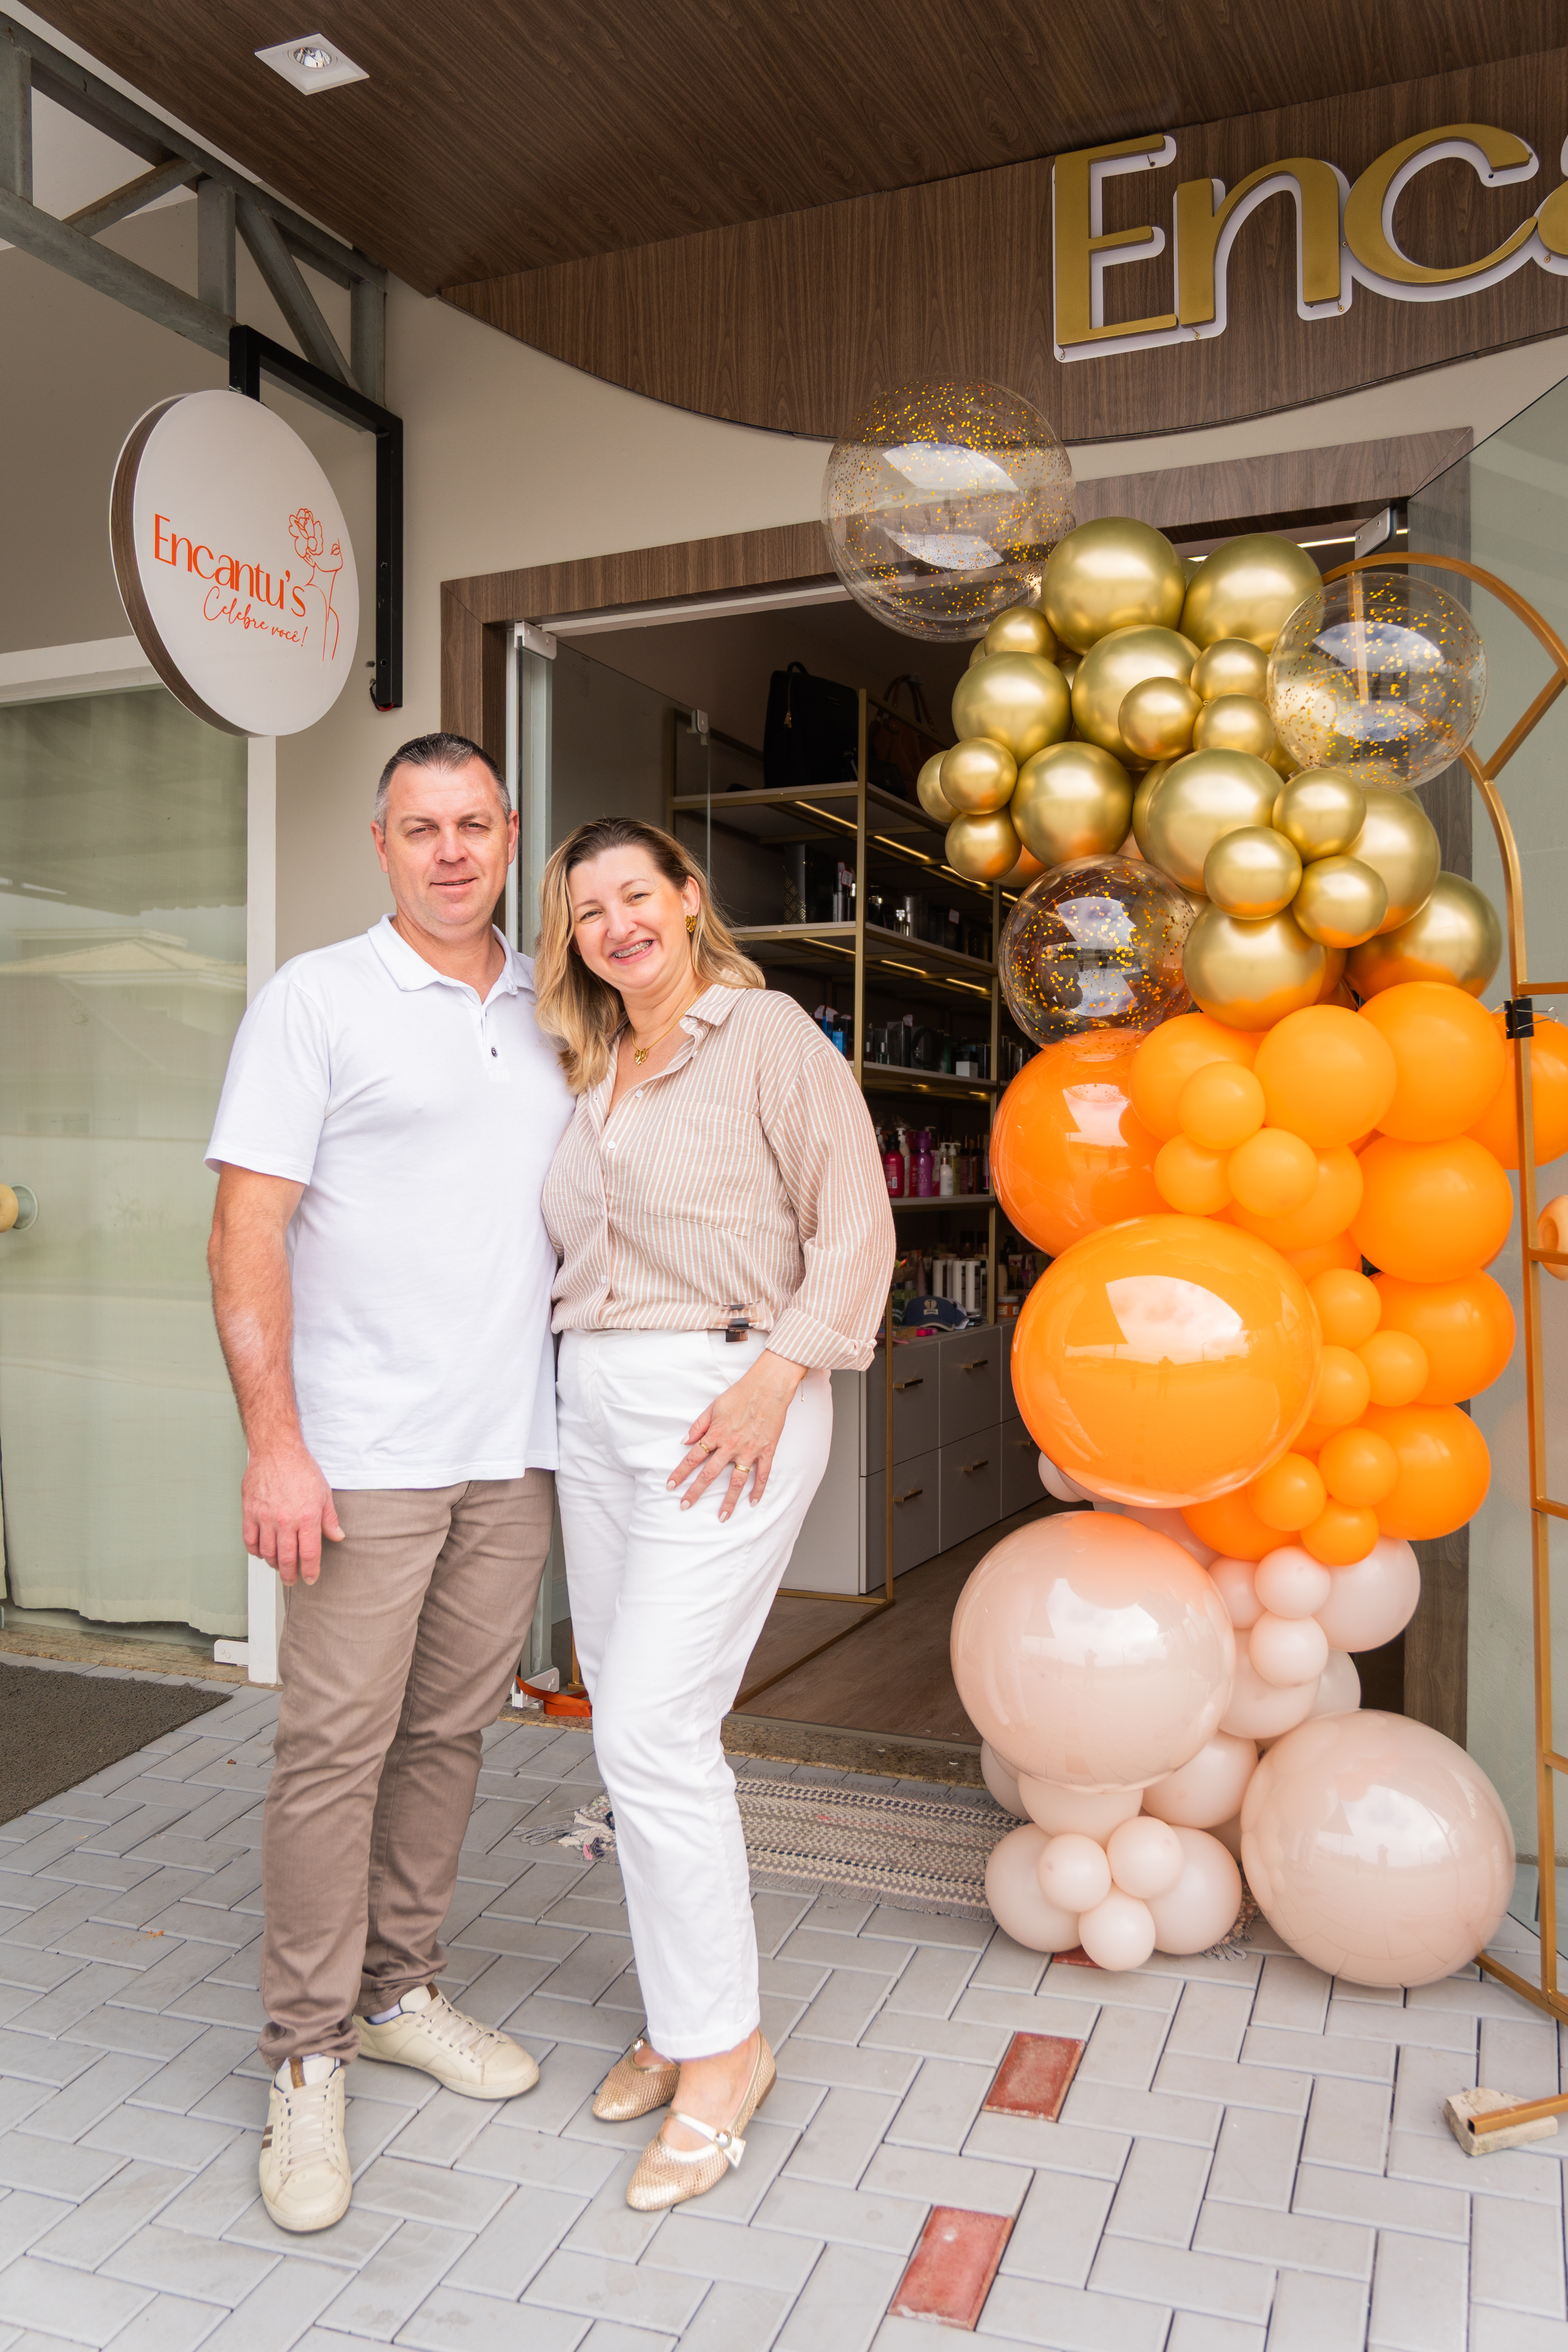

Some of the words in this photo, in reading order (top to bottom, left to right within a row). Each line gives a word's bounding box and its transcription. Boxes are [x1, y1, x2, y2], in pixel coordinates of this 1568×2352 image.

[1053, 124, 1568, 362] Enc
[154, 514, 306, 617] Encantu's
[203, 586, 269, 630] Celebre
[271, 626, 308, 647] você!
